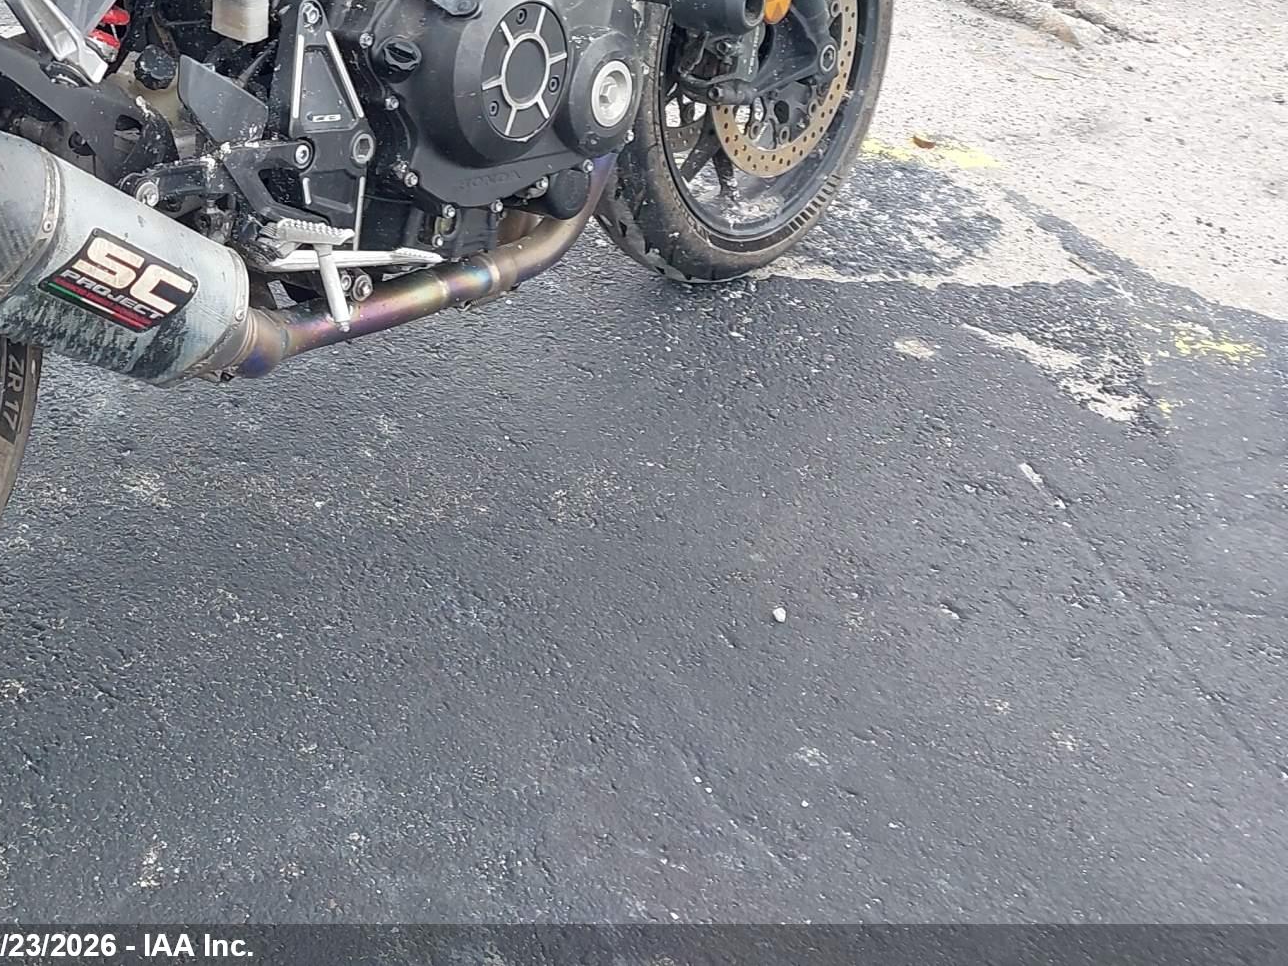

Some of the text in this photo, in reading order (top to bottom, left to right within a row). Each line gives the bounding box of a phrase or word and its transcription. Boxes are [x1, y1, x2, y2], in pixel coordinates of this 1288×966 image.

[59, 269, 164, 320] PROJECT
[72, 237, 192, 314] SC
[2, 353, 25, 432] ZR 17
